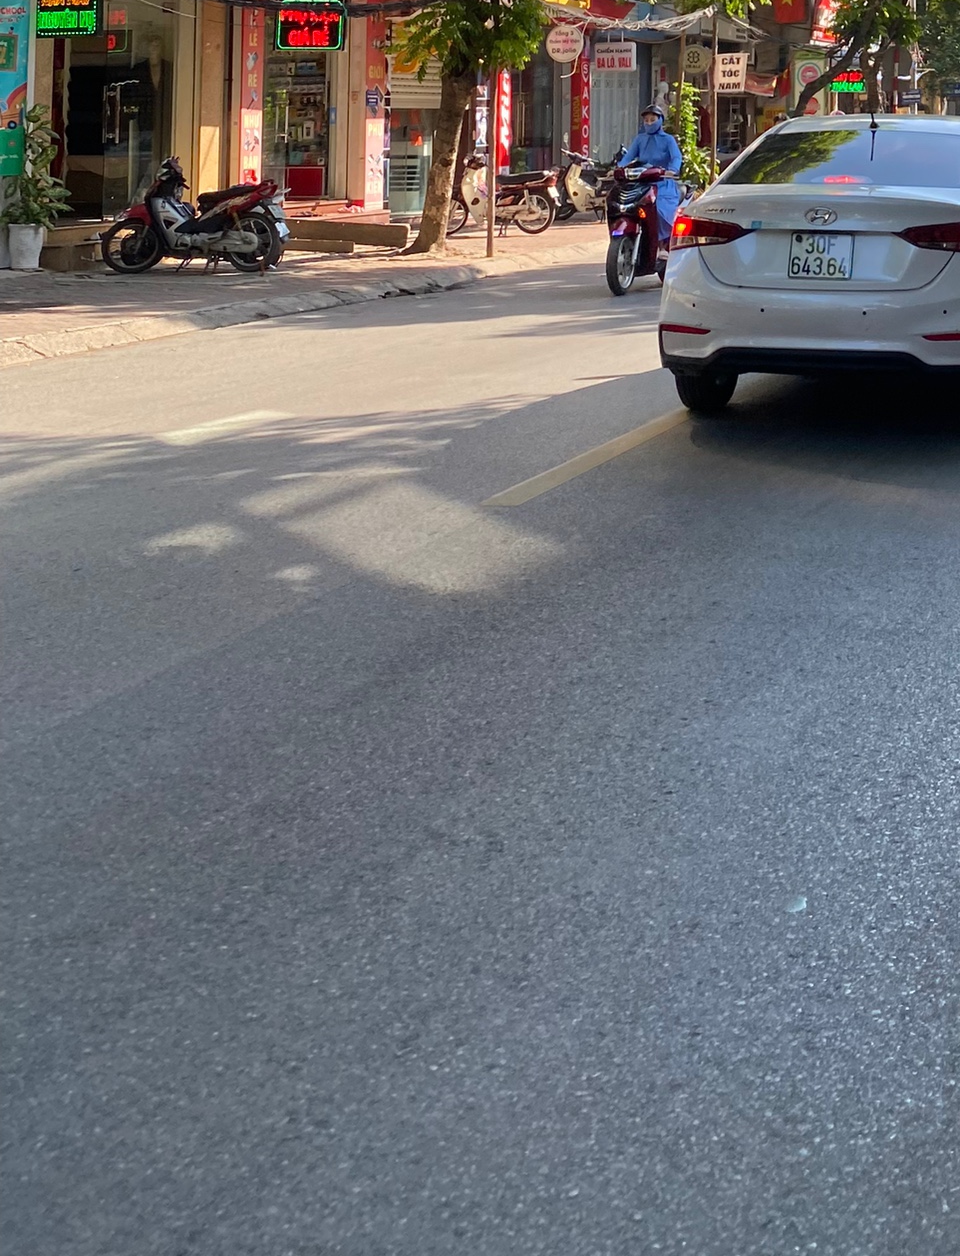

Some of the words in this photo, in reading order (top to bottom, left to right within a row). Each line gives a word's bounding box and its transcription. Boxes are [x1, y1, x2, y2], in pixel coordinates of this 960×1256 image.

[721, 68, 740, 77] TÓC
[718, 81, 740, 90] NAM
[805, 234, 839, 255] 30F
[790, 256, 848, 277] 643.64
